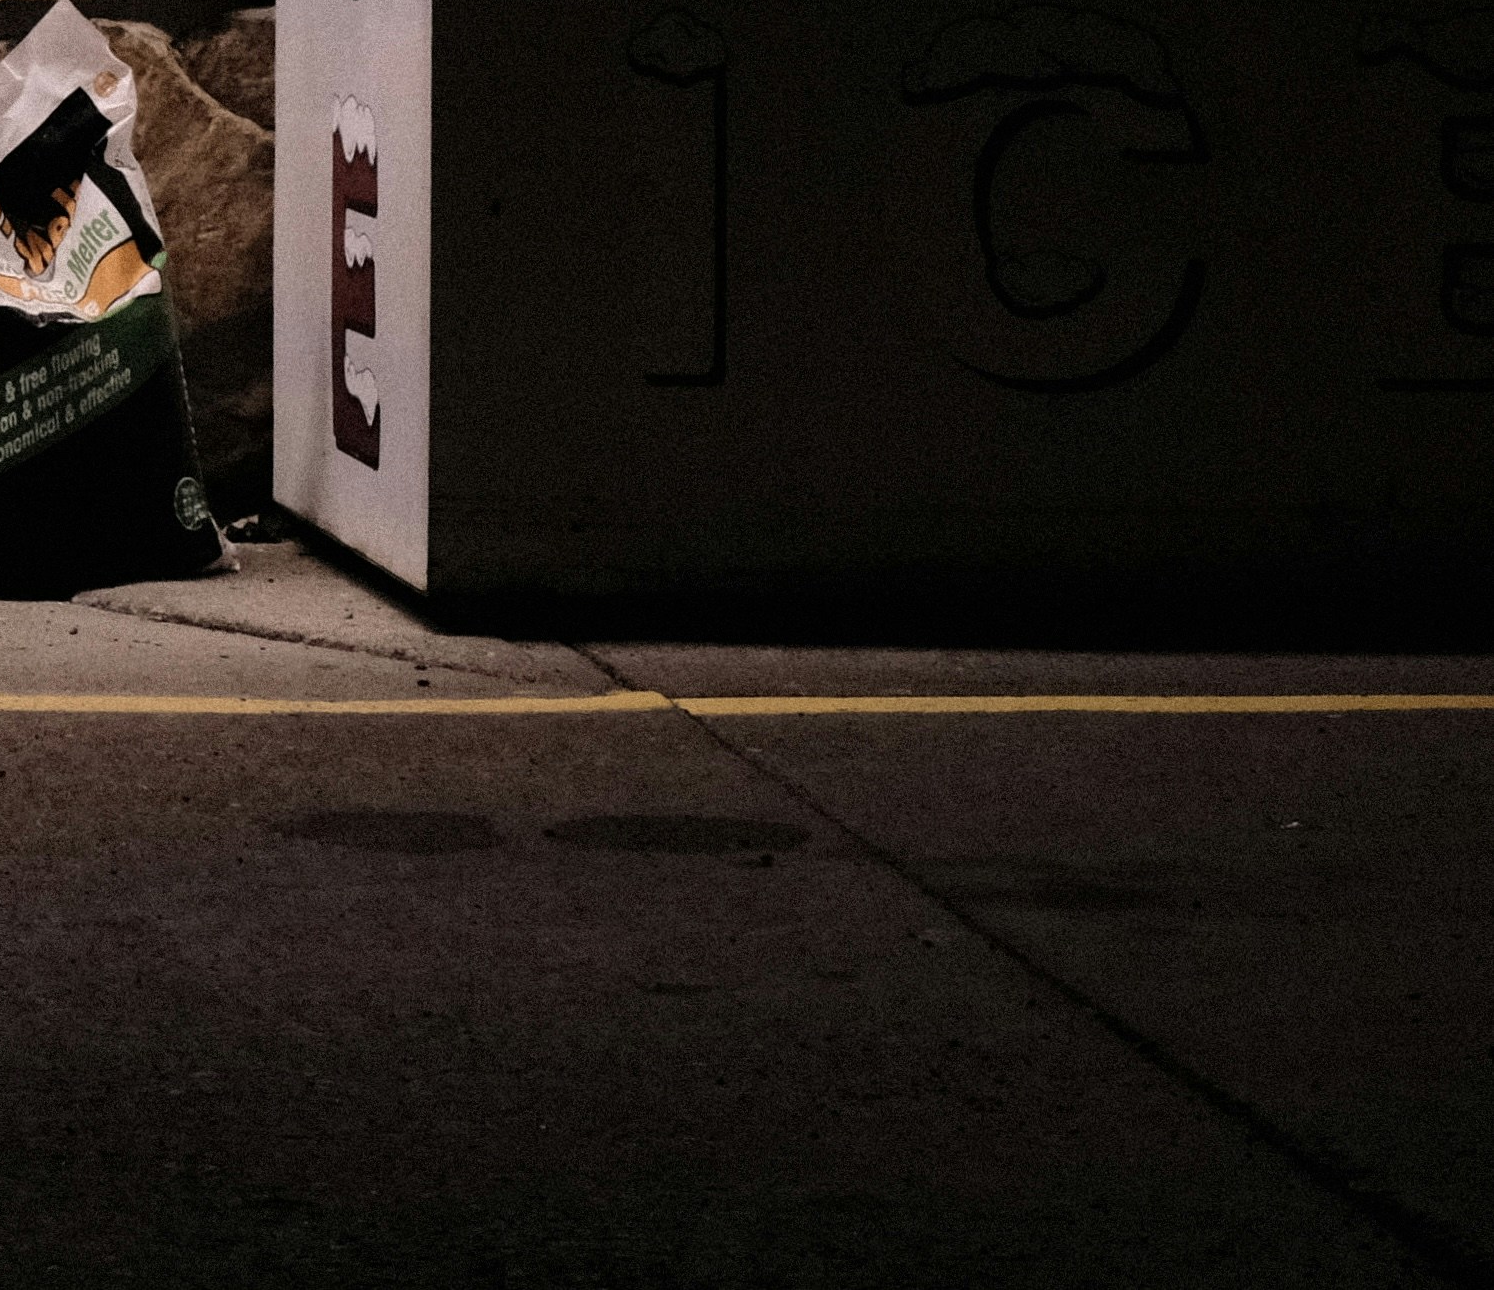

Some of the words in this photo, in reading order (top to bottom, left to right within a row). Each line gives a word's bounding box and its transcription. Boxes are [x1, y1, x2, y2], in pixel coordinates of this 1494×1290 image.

[66, 208, 120, 284] Melter
[5, 381, 16, 403] &
[19, 366, 47, 395] free
[51, 334, 101, 374] flowing
[65, 403, 75, 424] &
[79, 368, 131, 415] effective
[22, 399, 32, 421] &
